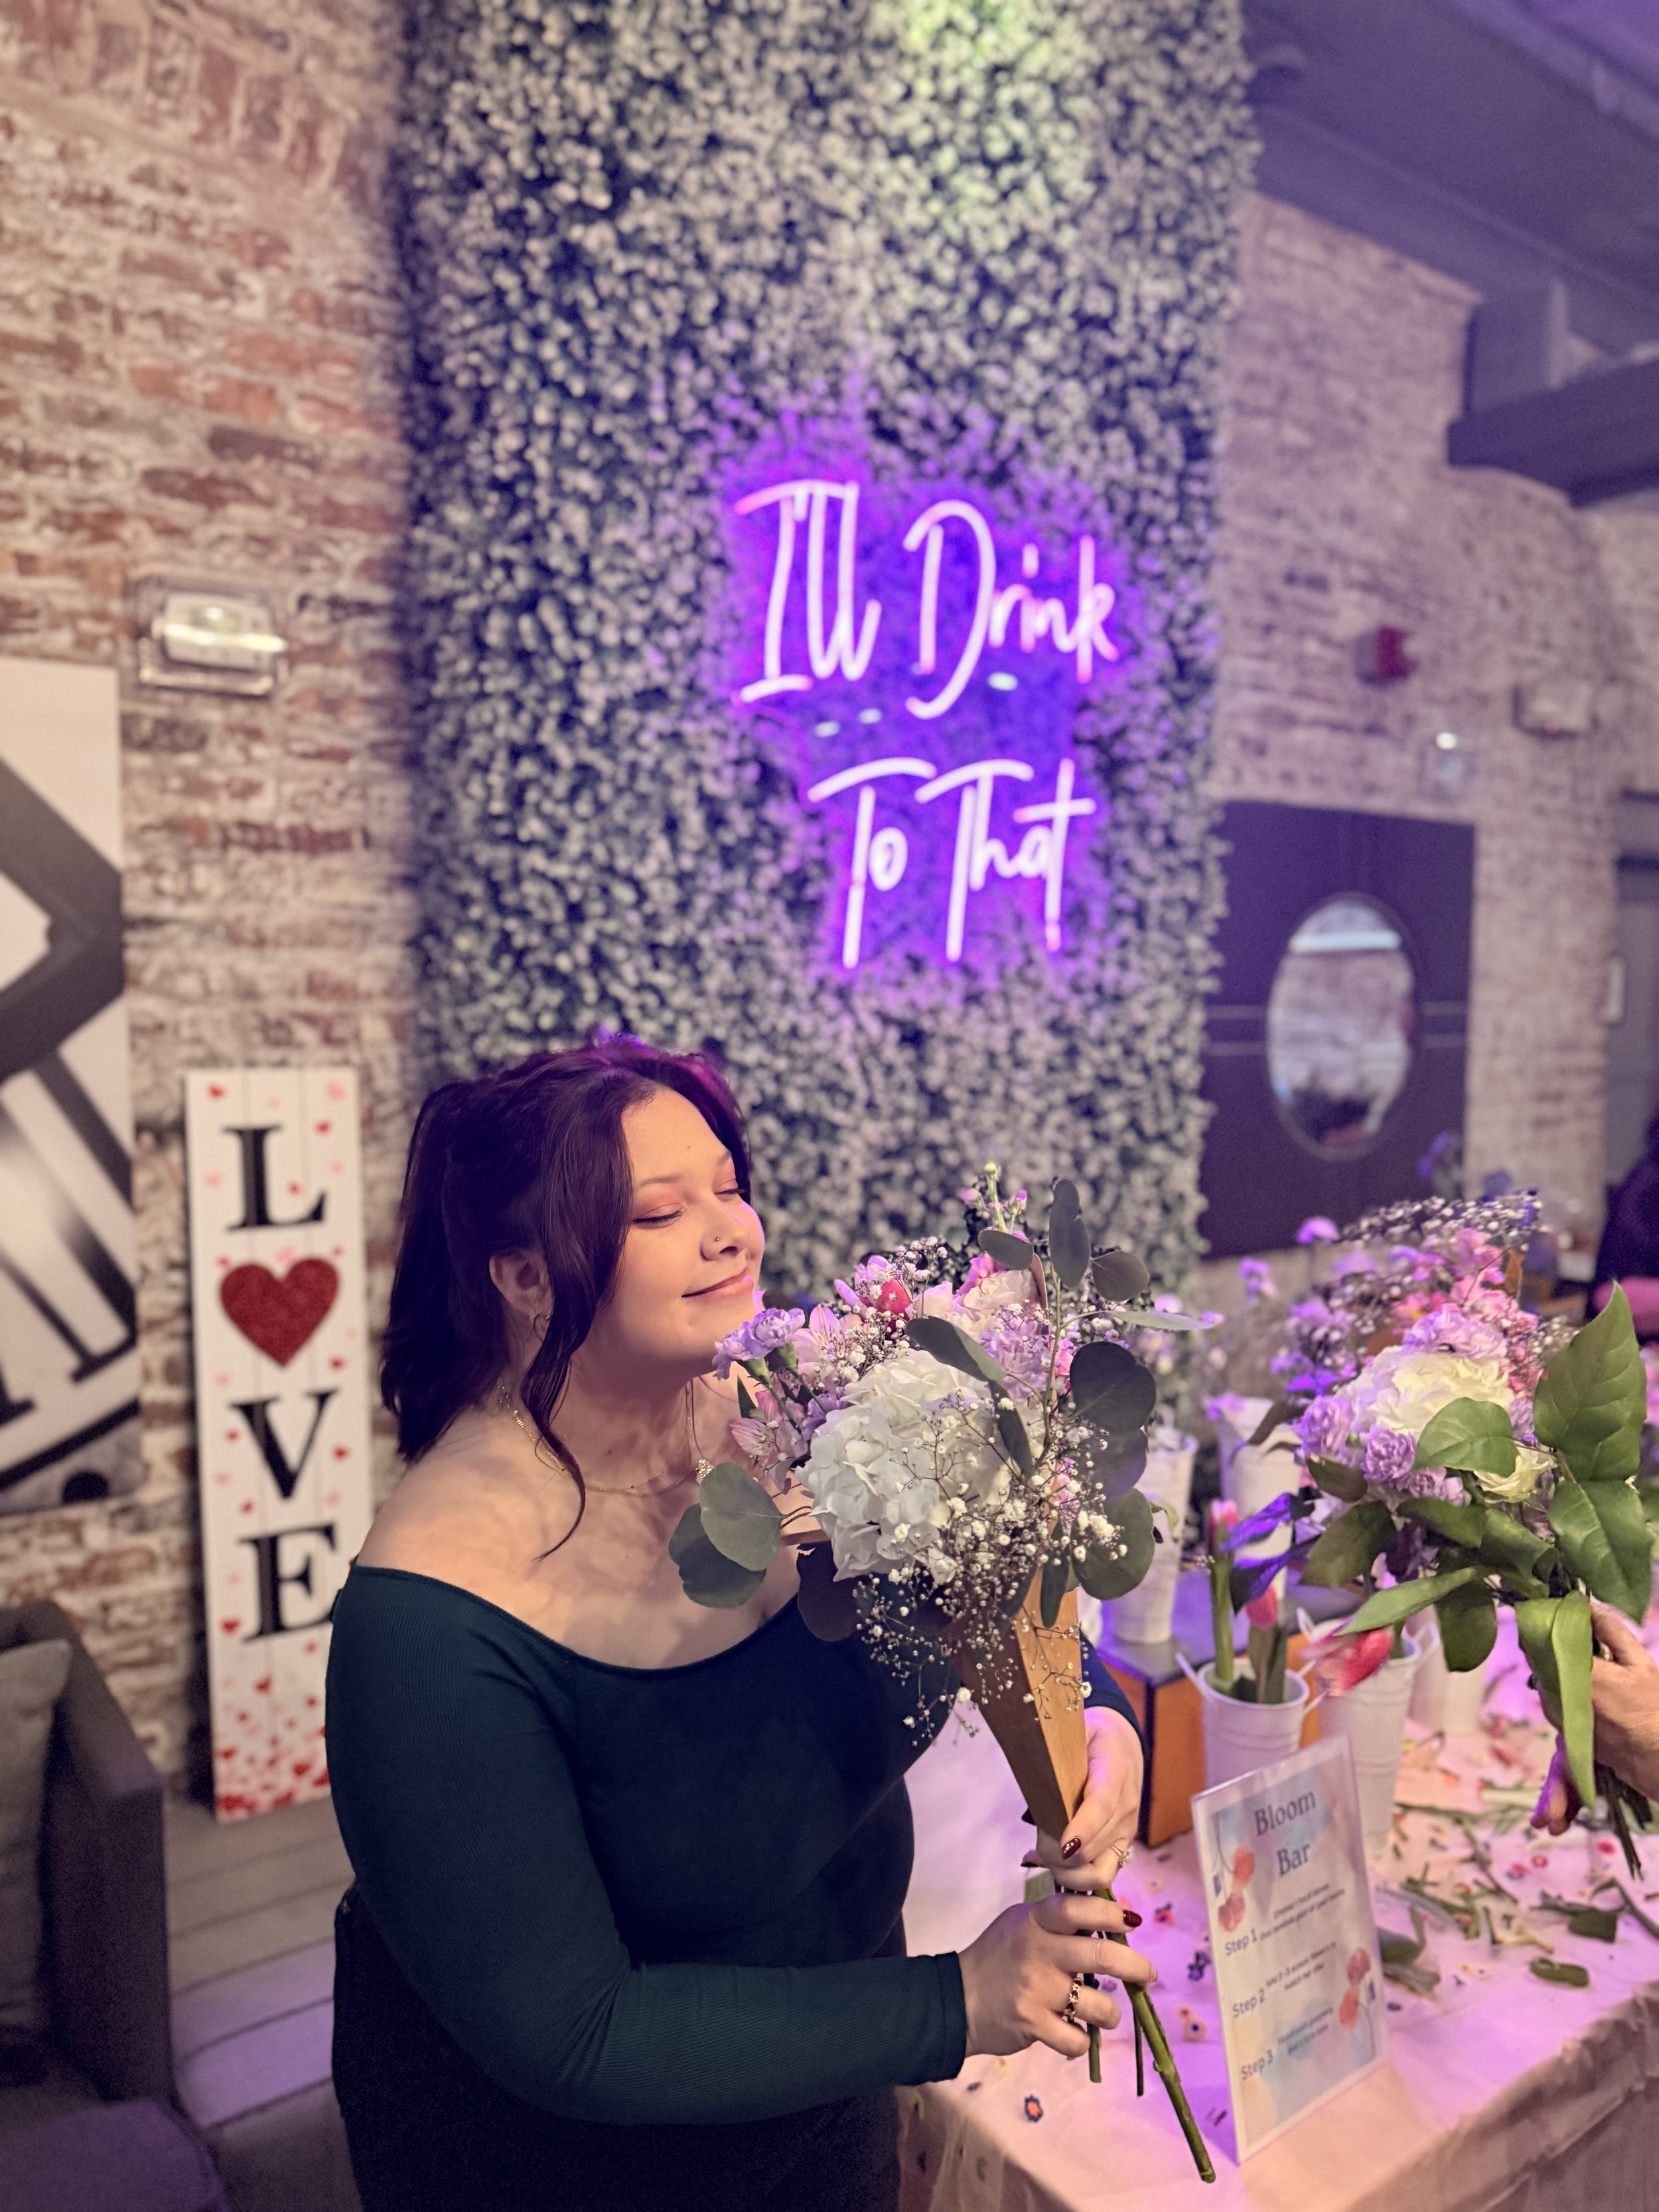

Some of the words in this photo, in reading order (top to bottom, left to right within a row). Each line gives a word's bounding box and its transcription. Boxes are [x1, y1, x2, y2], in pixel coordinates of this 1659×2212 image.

[902, 499, 1121, 719] Drink
[808, 757, 936, 969] To
[914, 757, 1098, 962] That
[1254, 1791, 1317, 1836] Bloom
[1276, 1844, 1311, 1878] Bar
[1224, 1935, 1249, 1956] Step
[1251, 1928, 1257, 1943] 1
[1232, 1996, 1257, 2018] Step
[1258, 1988, 1265, 2004] 2
[1241, 2057, 1265, 2081] Step
[1266, 2049, 1273, 2065] 3
